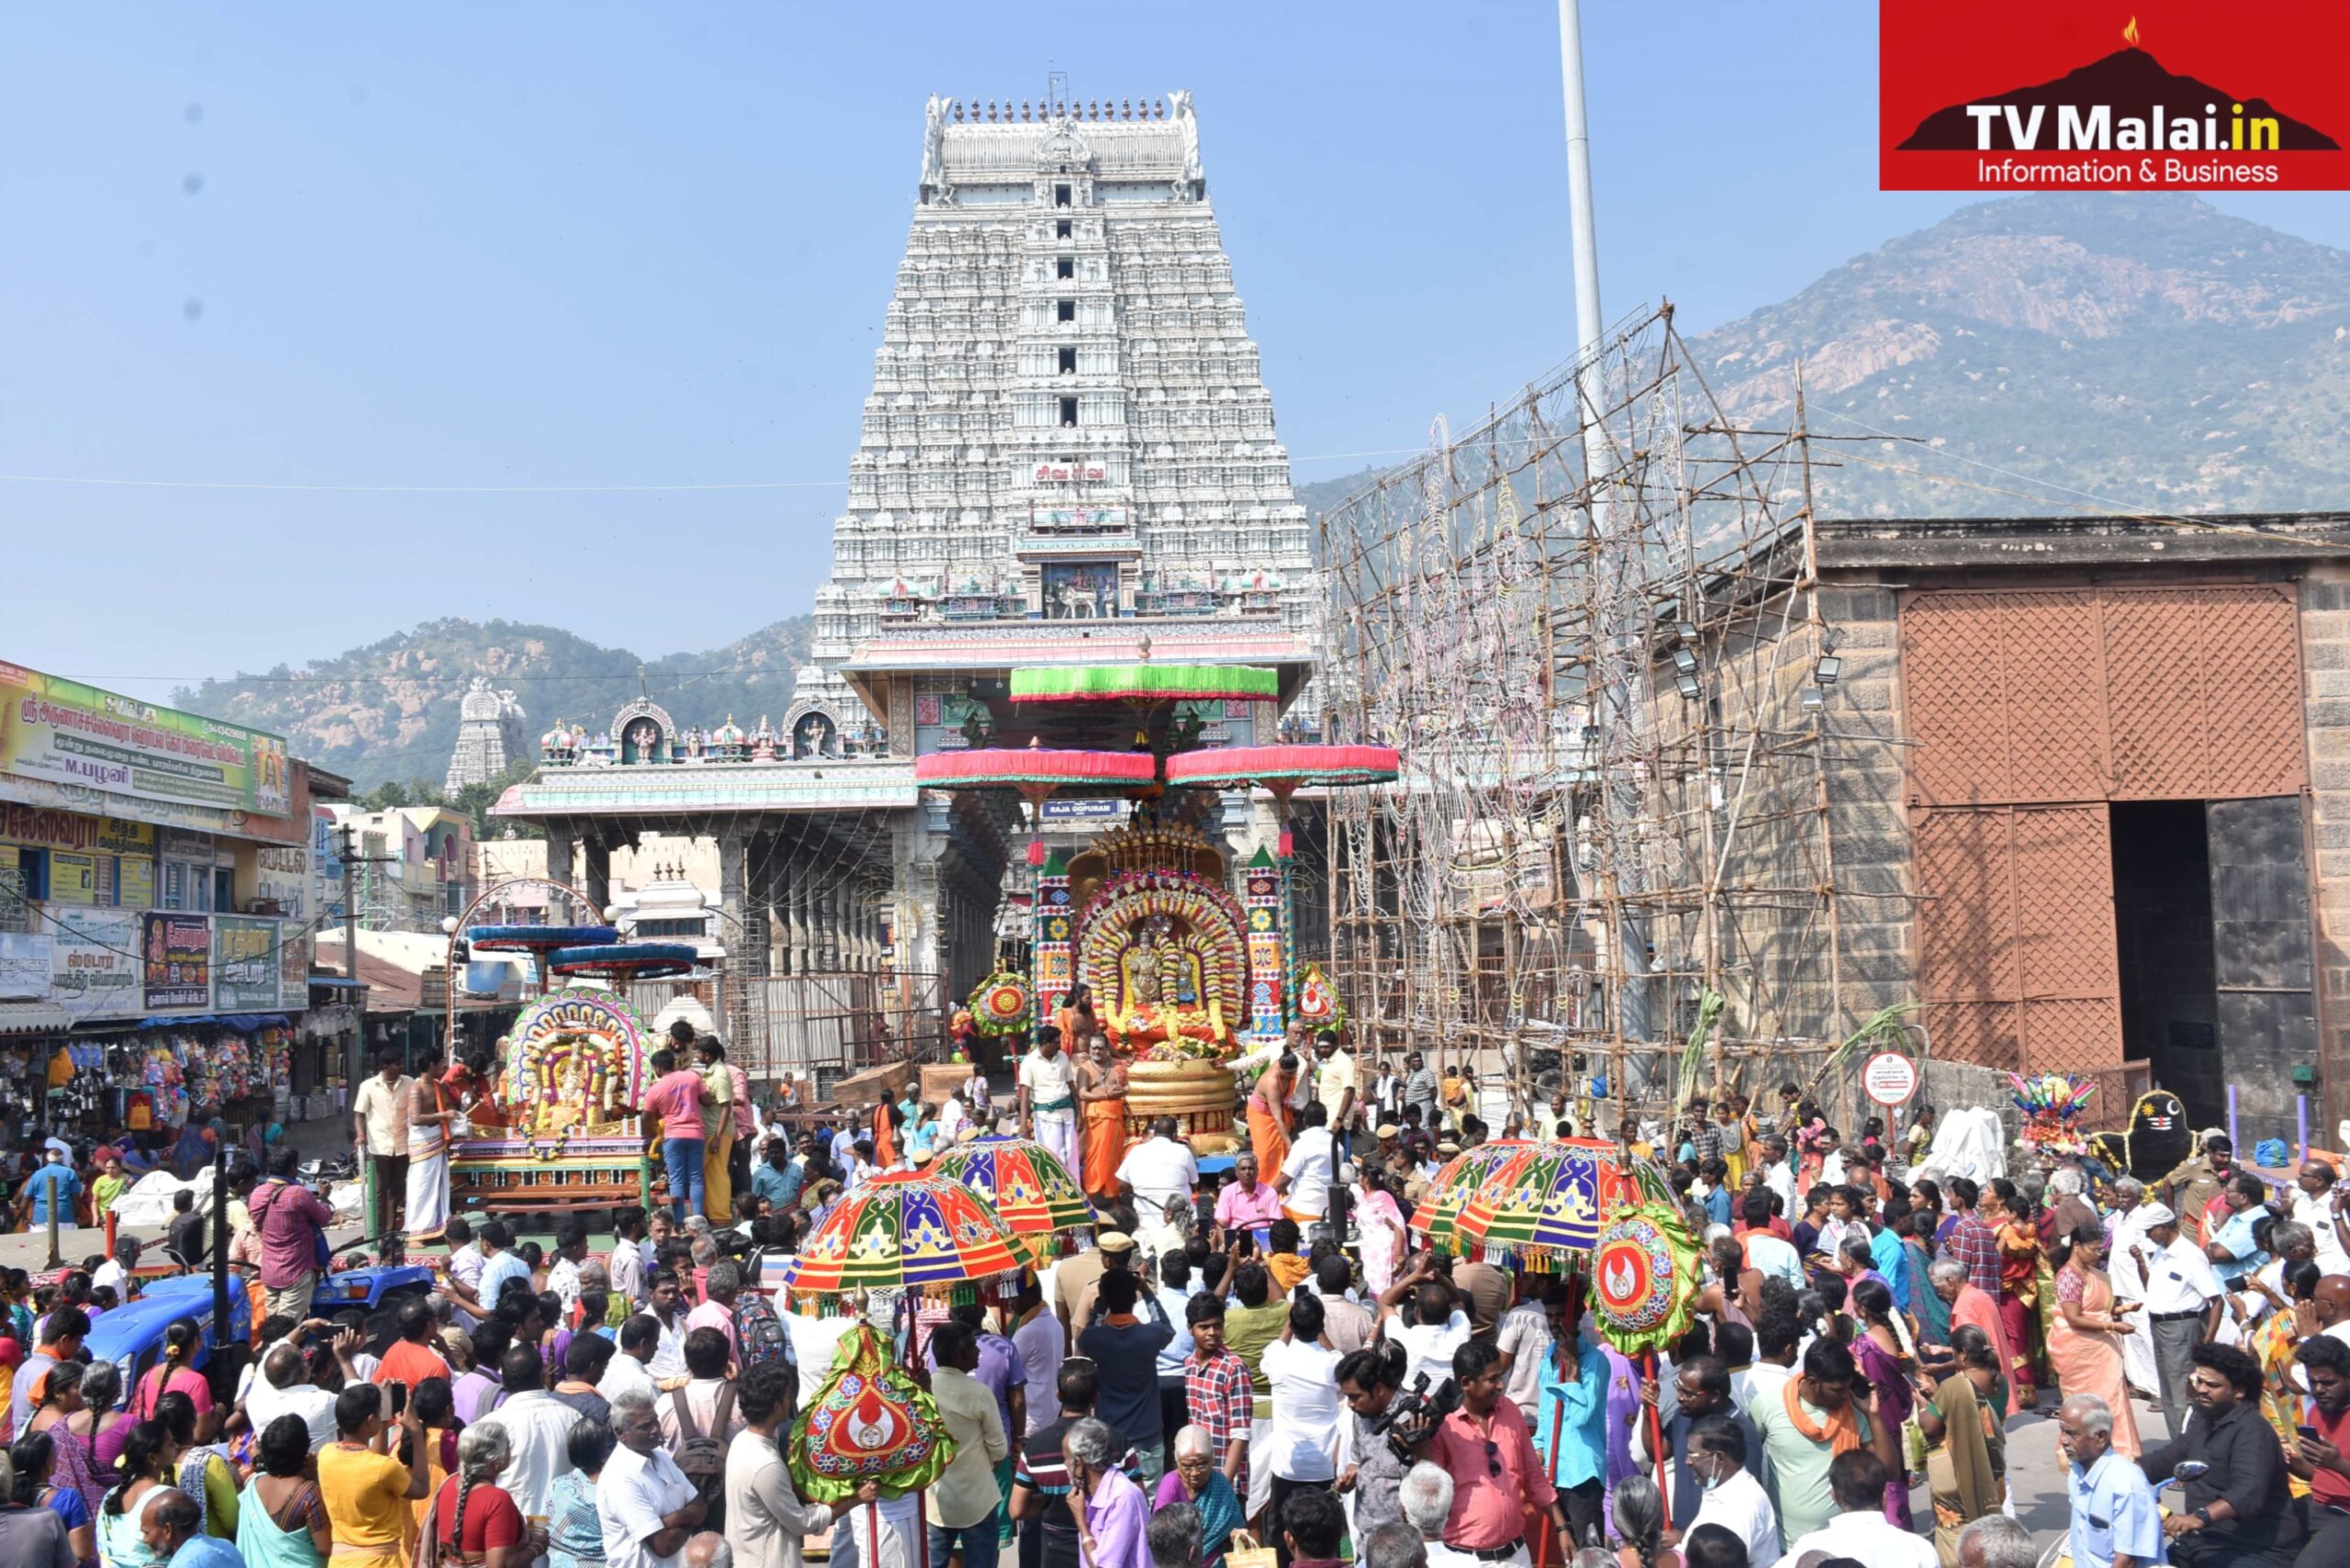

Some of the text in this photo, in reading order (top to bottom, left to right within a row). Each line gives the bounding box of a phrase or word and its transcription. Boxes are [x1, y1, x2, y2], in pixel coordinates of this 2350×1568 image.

[1035, 465, 1068, 480] சிவ
[65, 757, 129, 785] M.பழனி
[1071, 804, 1111, 812] GOPURAM
